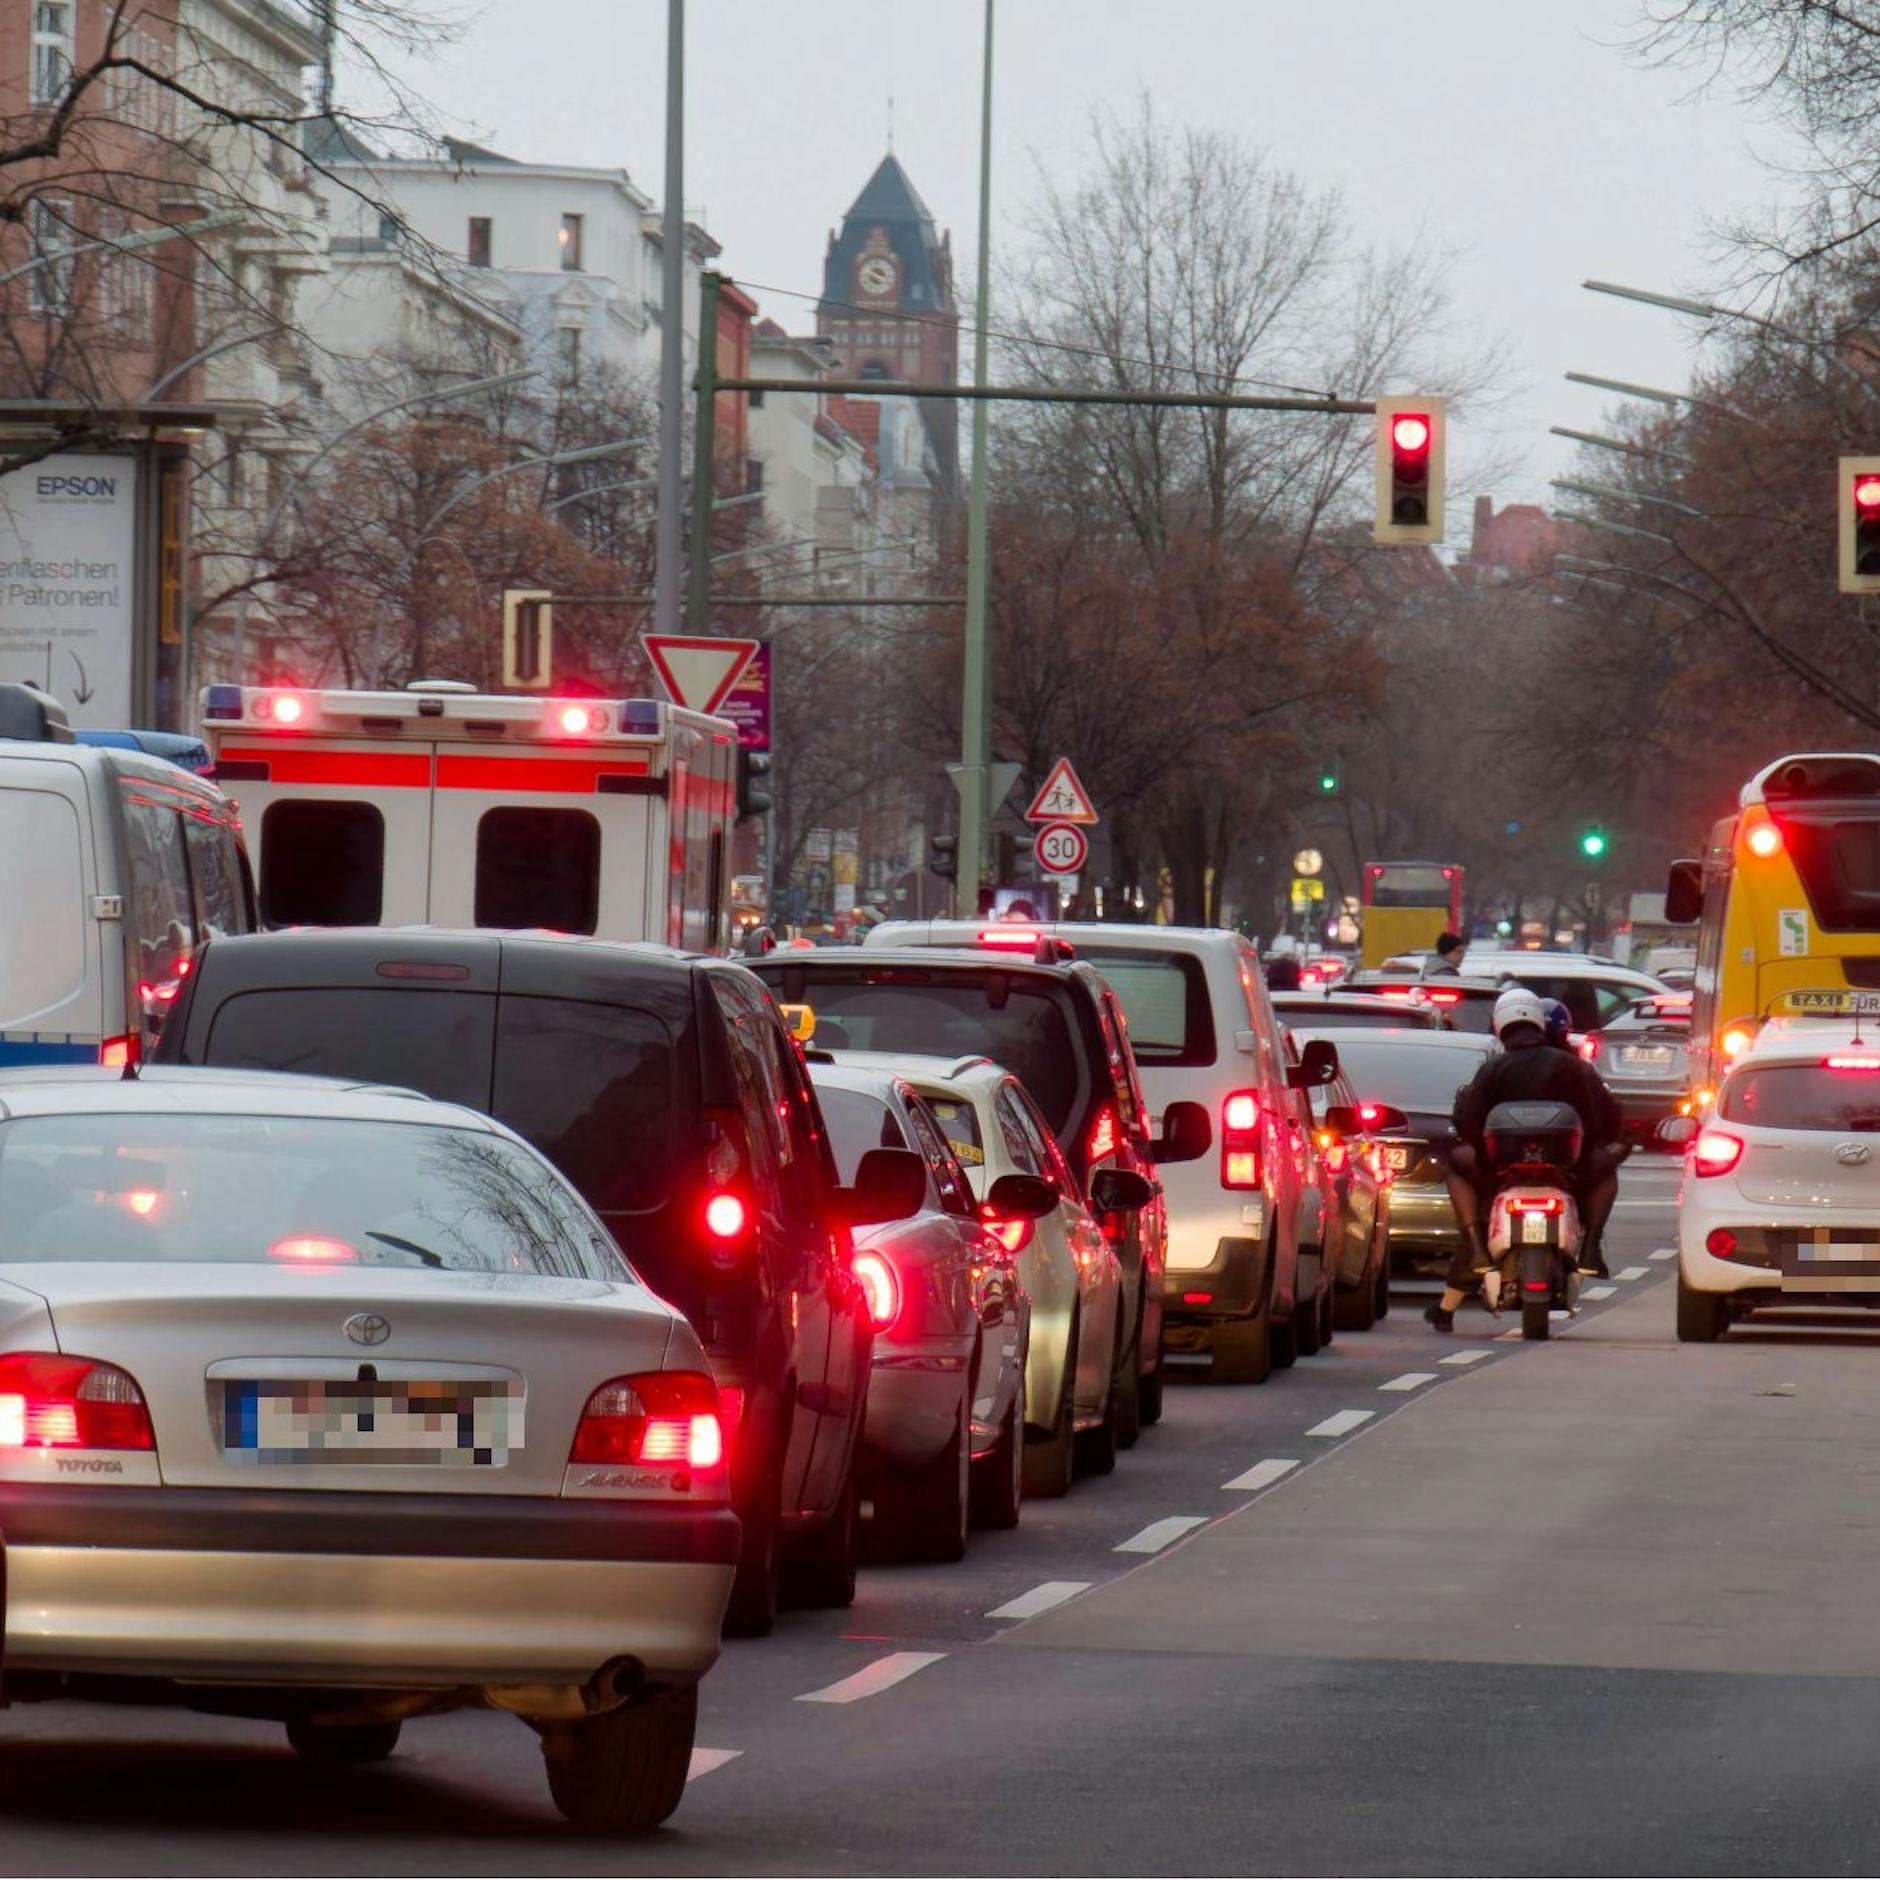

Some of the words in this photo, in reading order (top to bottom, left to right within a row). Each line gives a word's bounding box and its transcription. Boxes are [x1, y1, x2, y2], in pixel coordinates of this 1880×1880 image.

[37, 476, 115, 496] EPSON
[9, 583, 119, 607] Patronen!
[1048, 837, 1074, 858] 30
[1800, 994, 1838, 1006] TAXI
[55, 1459, 123, 1473] TOYOTA
